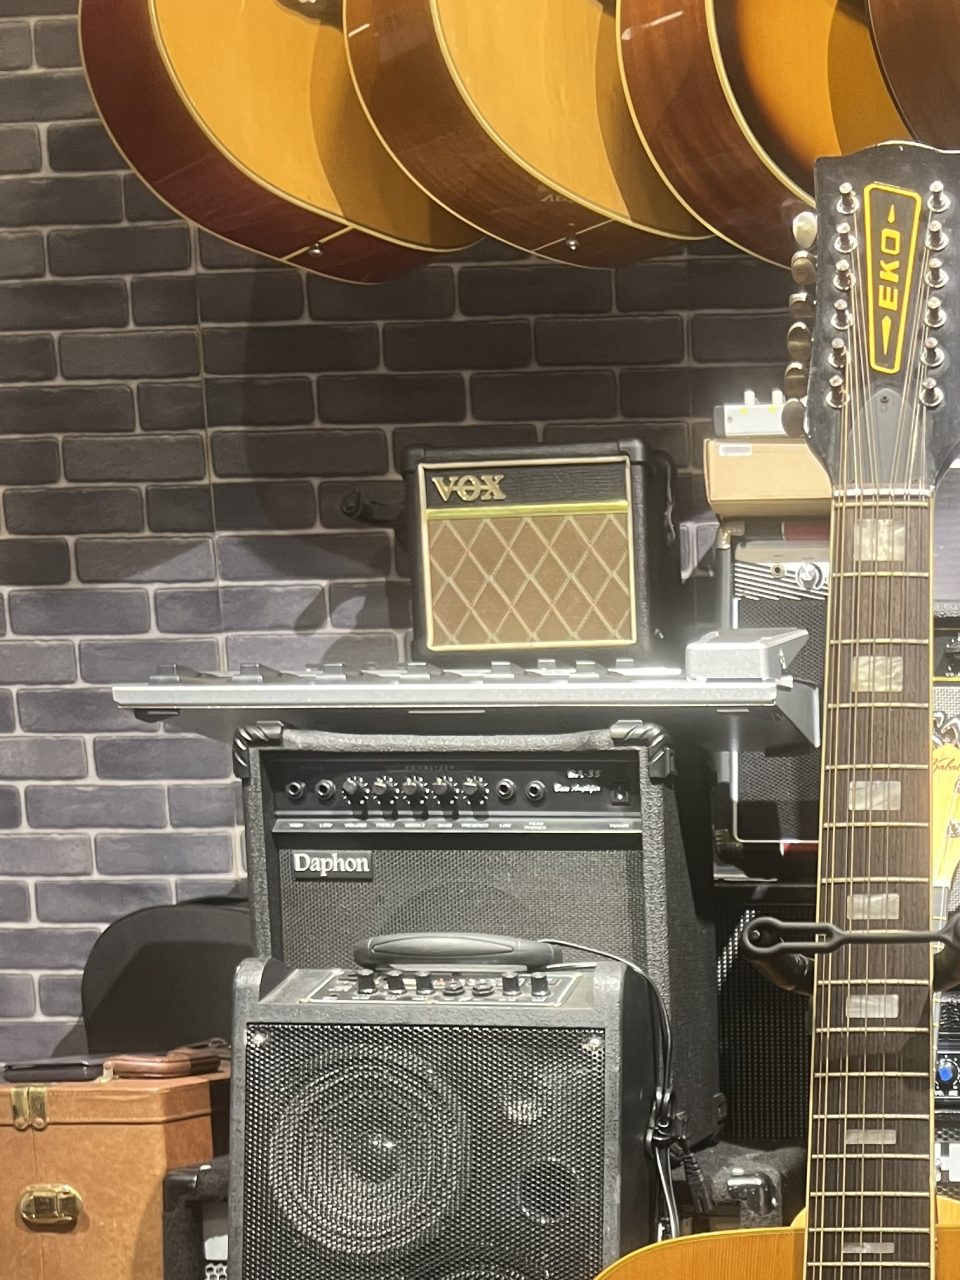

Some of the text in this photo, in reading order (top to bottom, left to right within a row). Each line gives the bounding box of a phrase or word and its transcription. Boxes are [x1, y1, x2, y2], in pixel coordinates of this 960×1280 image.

[878, 228, 901, 311] EKO
[432, 474, 507, 502] VOX
[293, 852, 370, 877] Daphon
